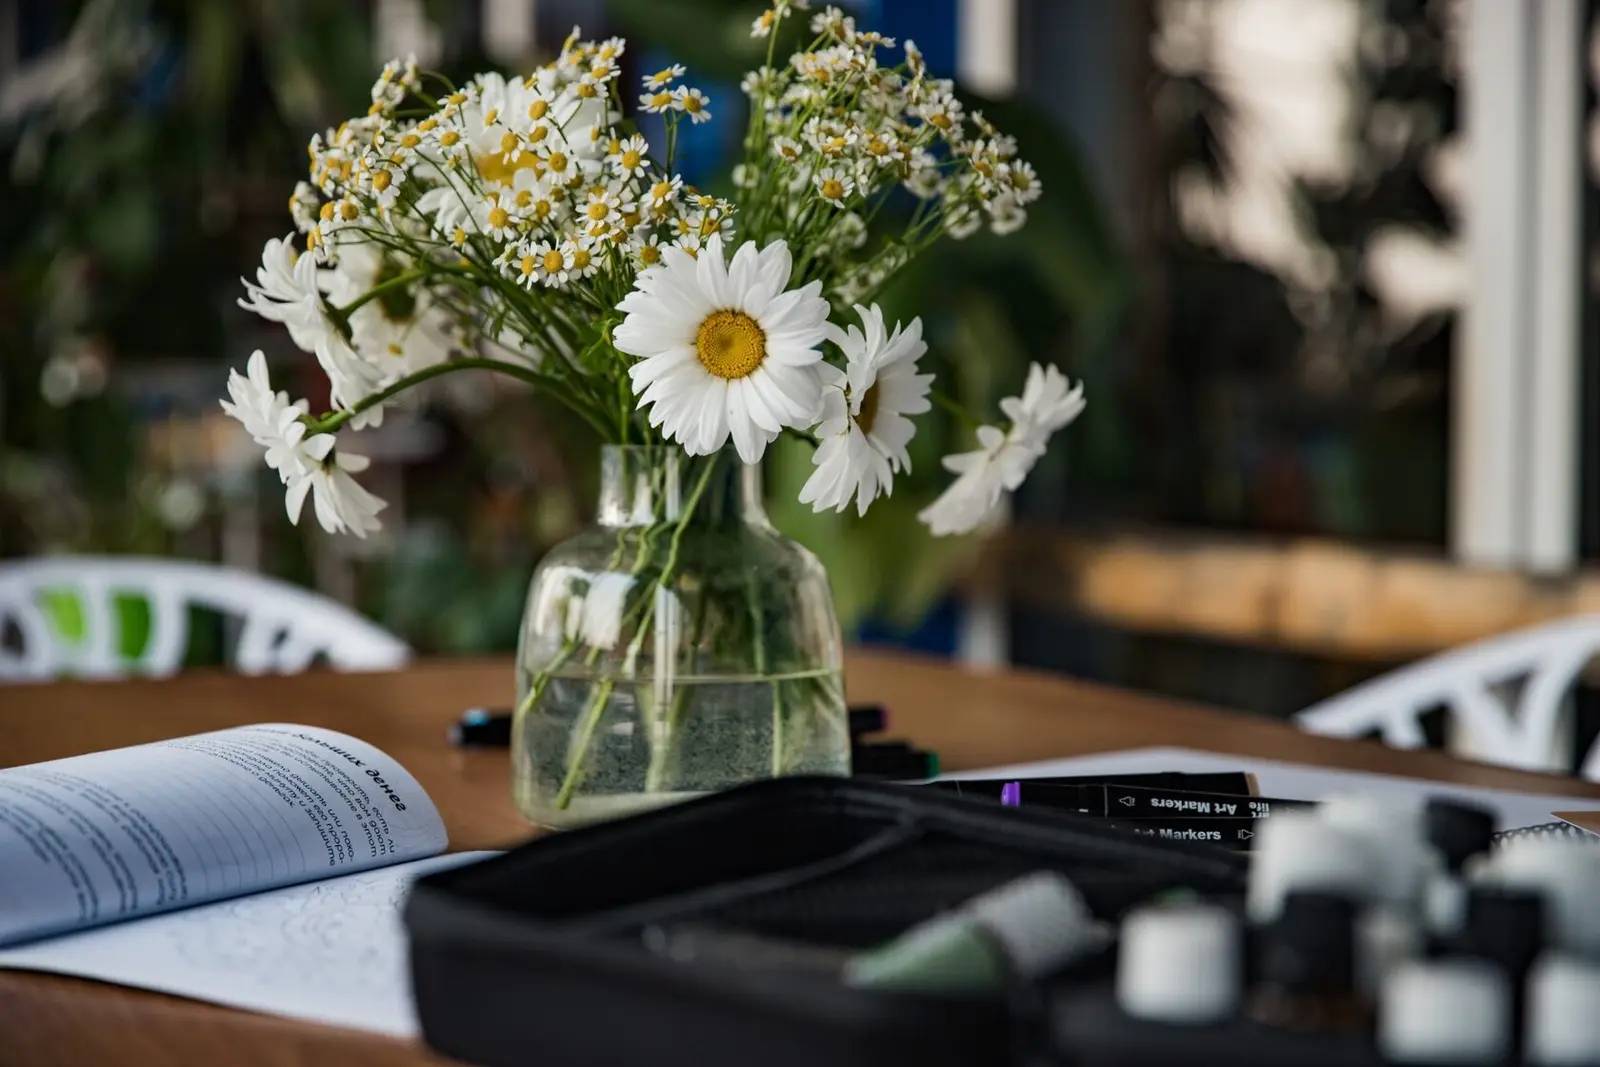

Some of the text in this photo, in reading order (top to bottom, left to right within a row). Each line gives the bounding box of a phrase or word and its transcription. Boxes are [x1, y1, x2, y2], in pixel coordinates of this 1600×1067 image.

[365, 769, 406, 812] денег
[1150, 798, 1237, 815] Art Markers
[1249, 802, 1270, 812] life
[272, 768, 314, 802] поможет
[313, 804, 328, 821] его
[326, 824, 344, 864] прора-
[290, 773, 327, 806] дышать
[328, 808, 342, 827] или
[341, 830, 354, 862] похо-
[305, 808, 336, 866] запишите
[337, 777, 386, 855] что вам дают
[372, 807, 390, 834] есть
[387, 838, 396, 853] ли
[1159, 828, 1222, 840] Markers
